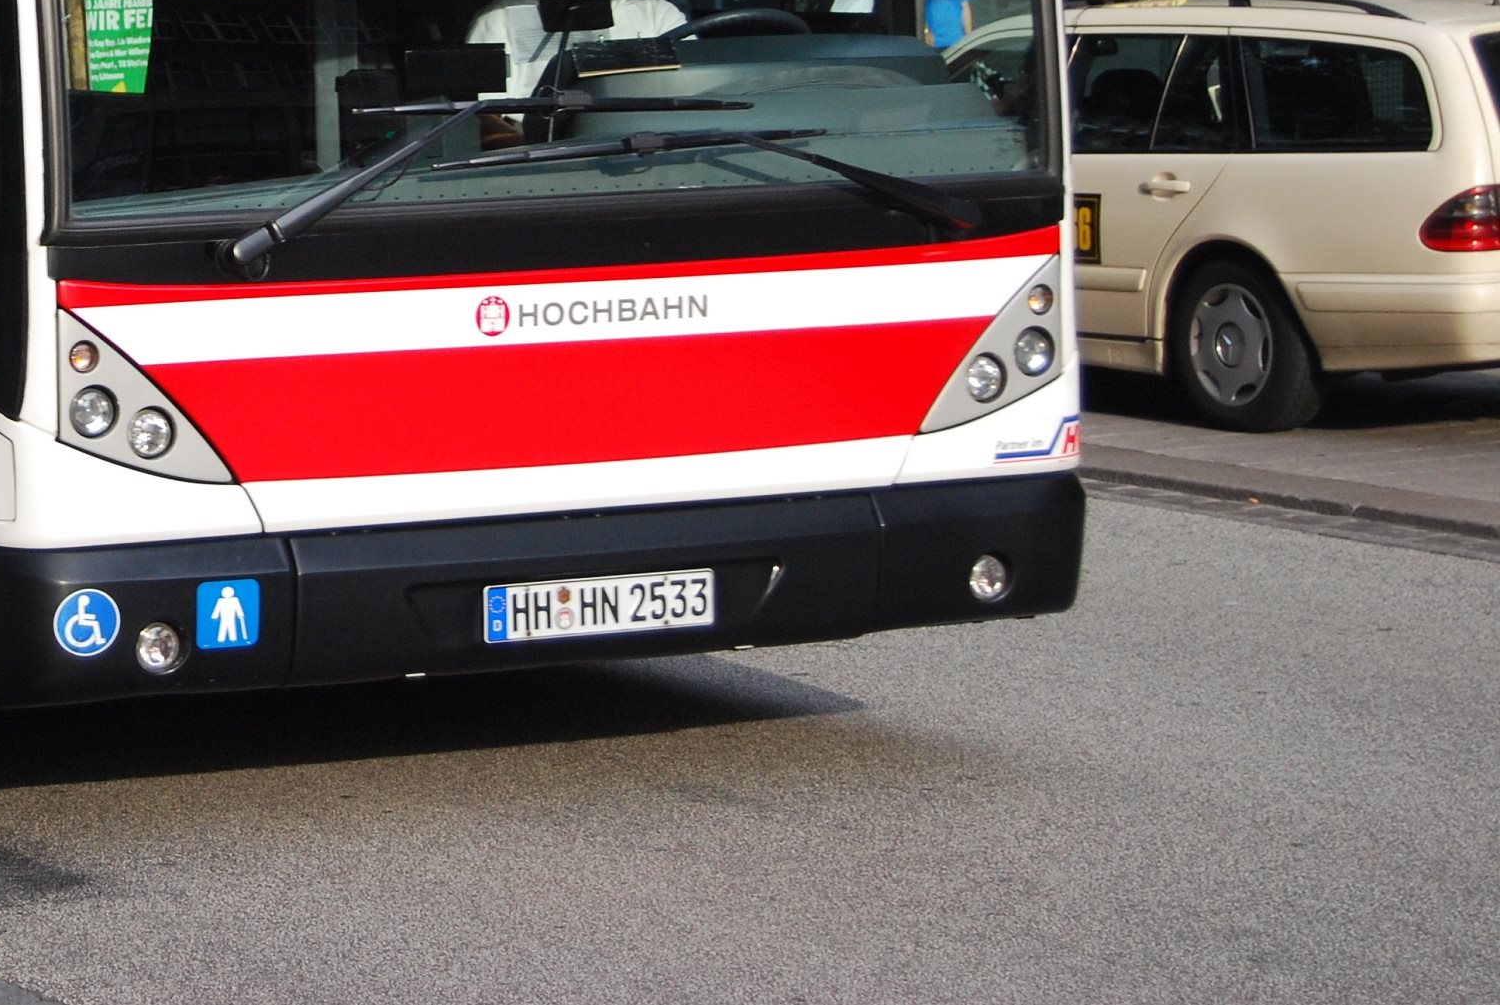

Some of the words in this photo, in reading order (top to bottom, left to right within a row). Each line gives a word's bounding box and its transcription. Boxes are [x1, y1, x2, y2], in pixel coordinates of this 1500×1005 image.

[86, 10, 120, 30] WIR
[518, 295, 708, 327] HOCHBAHN
[512, 590, 551, 632] HH
[580, 585, 619, 626] HN
[630, 578, 707, 623] 2533
[493, 619, 502, 632] D
